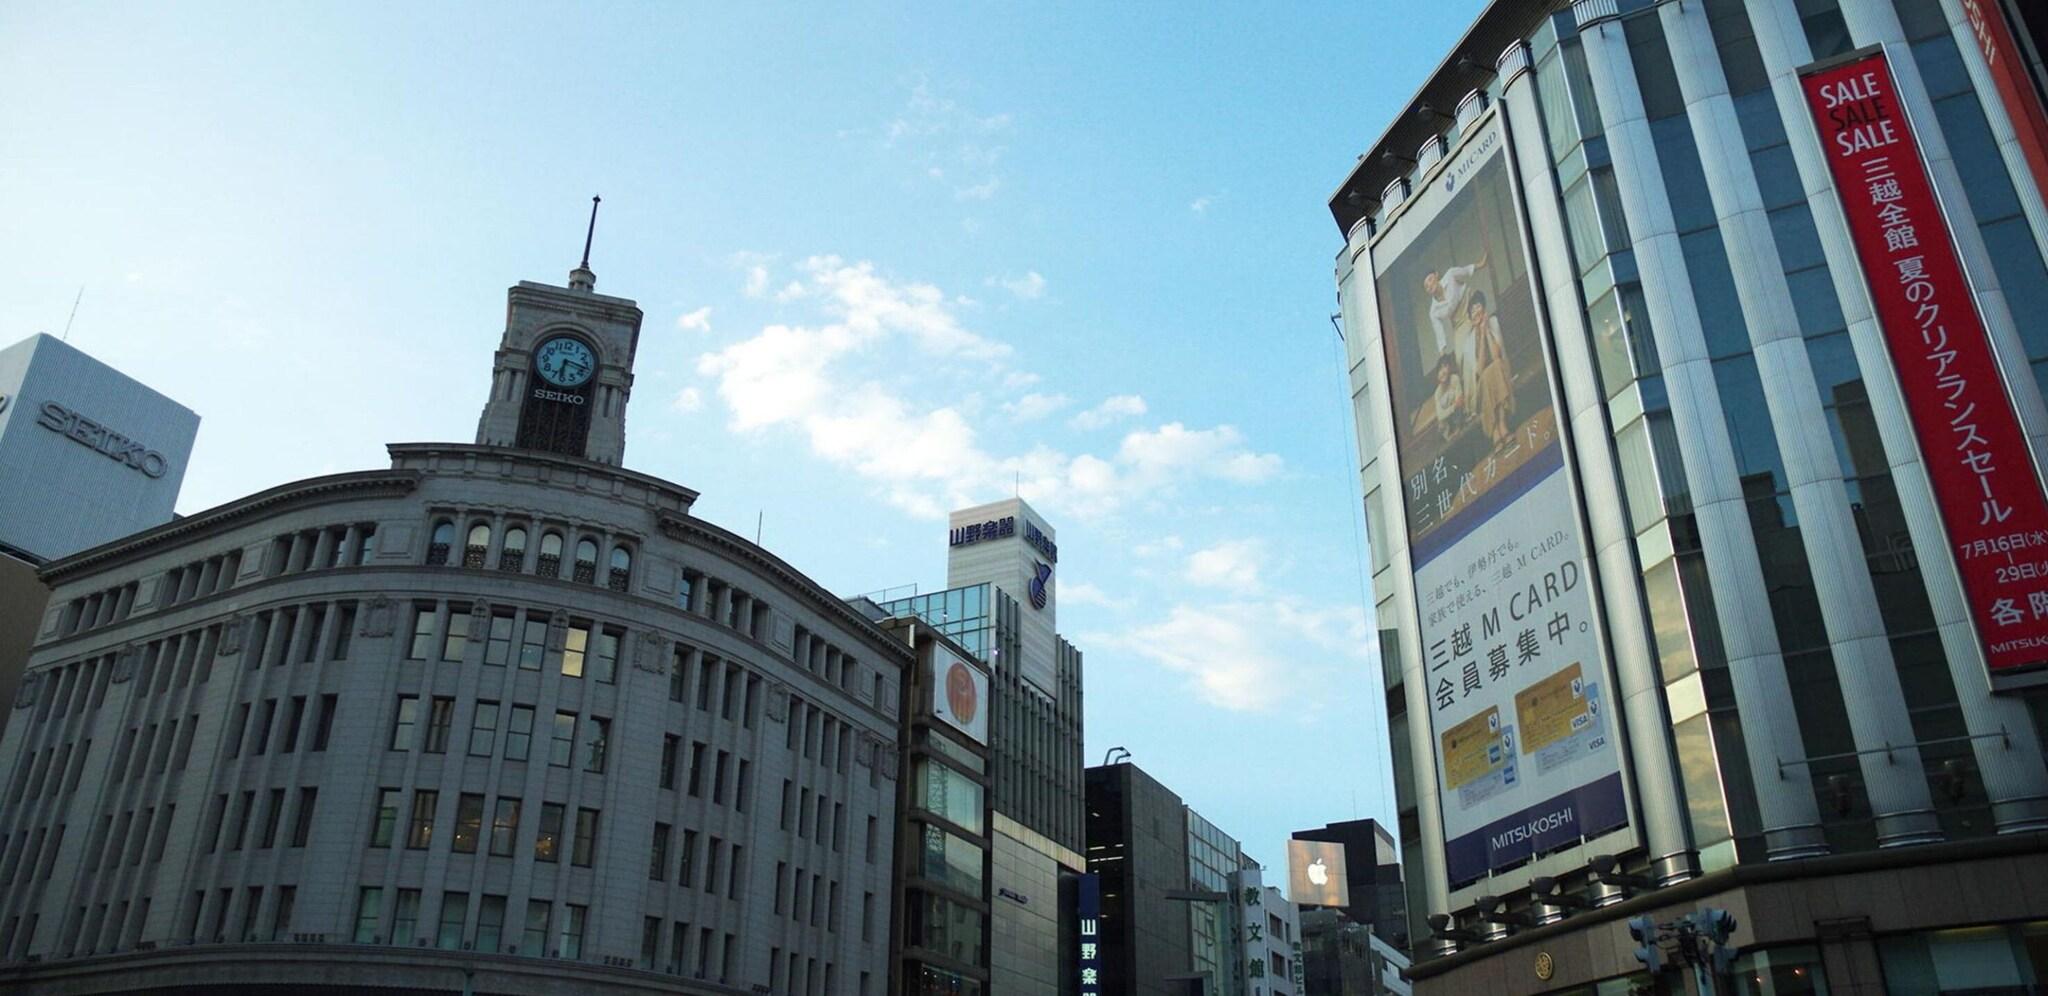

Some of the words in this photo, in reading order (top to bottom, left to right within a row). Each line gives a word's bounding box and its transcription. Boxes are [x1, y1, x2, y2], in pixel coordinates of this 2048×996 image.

[1820, 73, 1880, 109] SALE
[1829, 97, 1889, 131] SALE
[1836, 120, 1899, 156] SALE
[1862, 157, 1918, 252] 三越全館
[1893, 255, 2013, 525] 夏のクリアランスセール
[534, 388, 585, 405] SEIKO
[37, 400, 168, 479] SEIKO
[1410, 455, 1458, 500] 別名、
[1415, 420, 1550, 535] 三世代カード。
[950, 515, 1014, 547] 山野楽器
[1430, 622, 1473, 672] 三越
[1481, 607, 1501, 640] M
[1510, 560, 1578, 621] CARD
[1436, 611, 1588, 711] 会員募集中。
[1572, 716, 1588, 729] VISA
[1589, 737, 1605, 750] VISA
[1492, 807, 1573, 851] MITSUKOSHI
[1081, 919, 1097, 996] 山野楽
